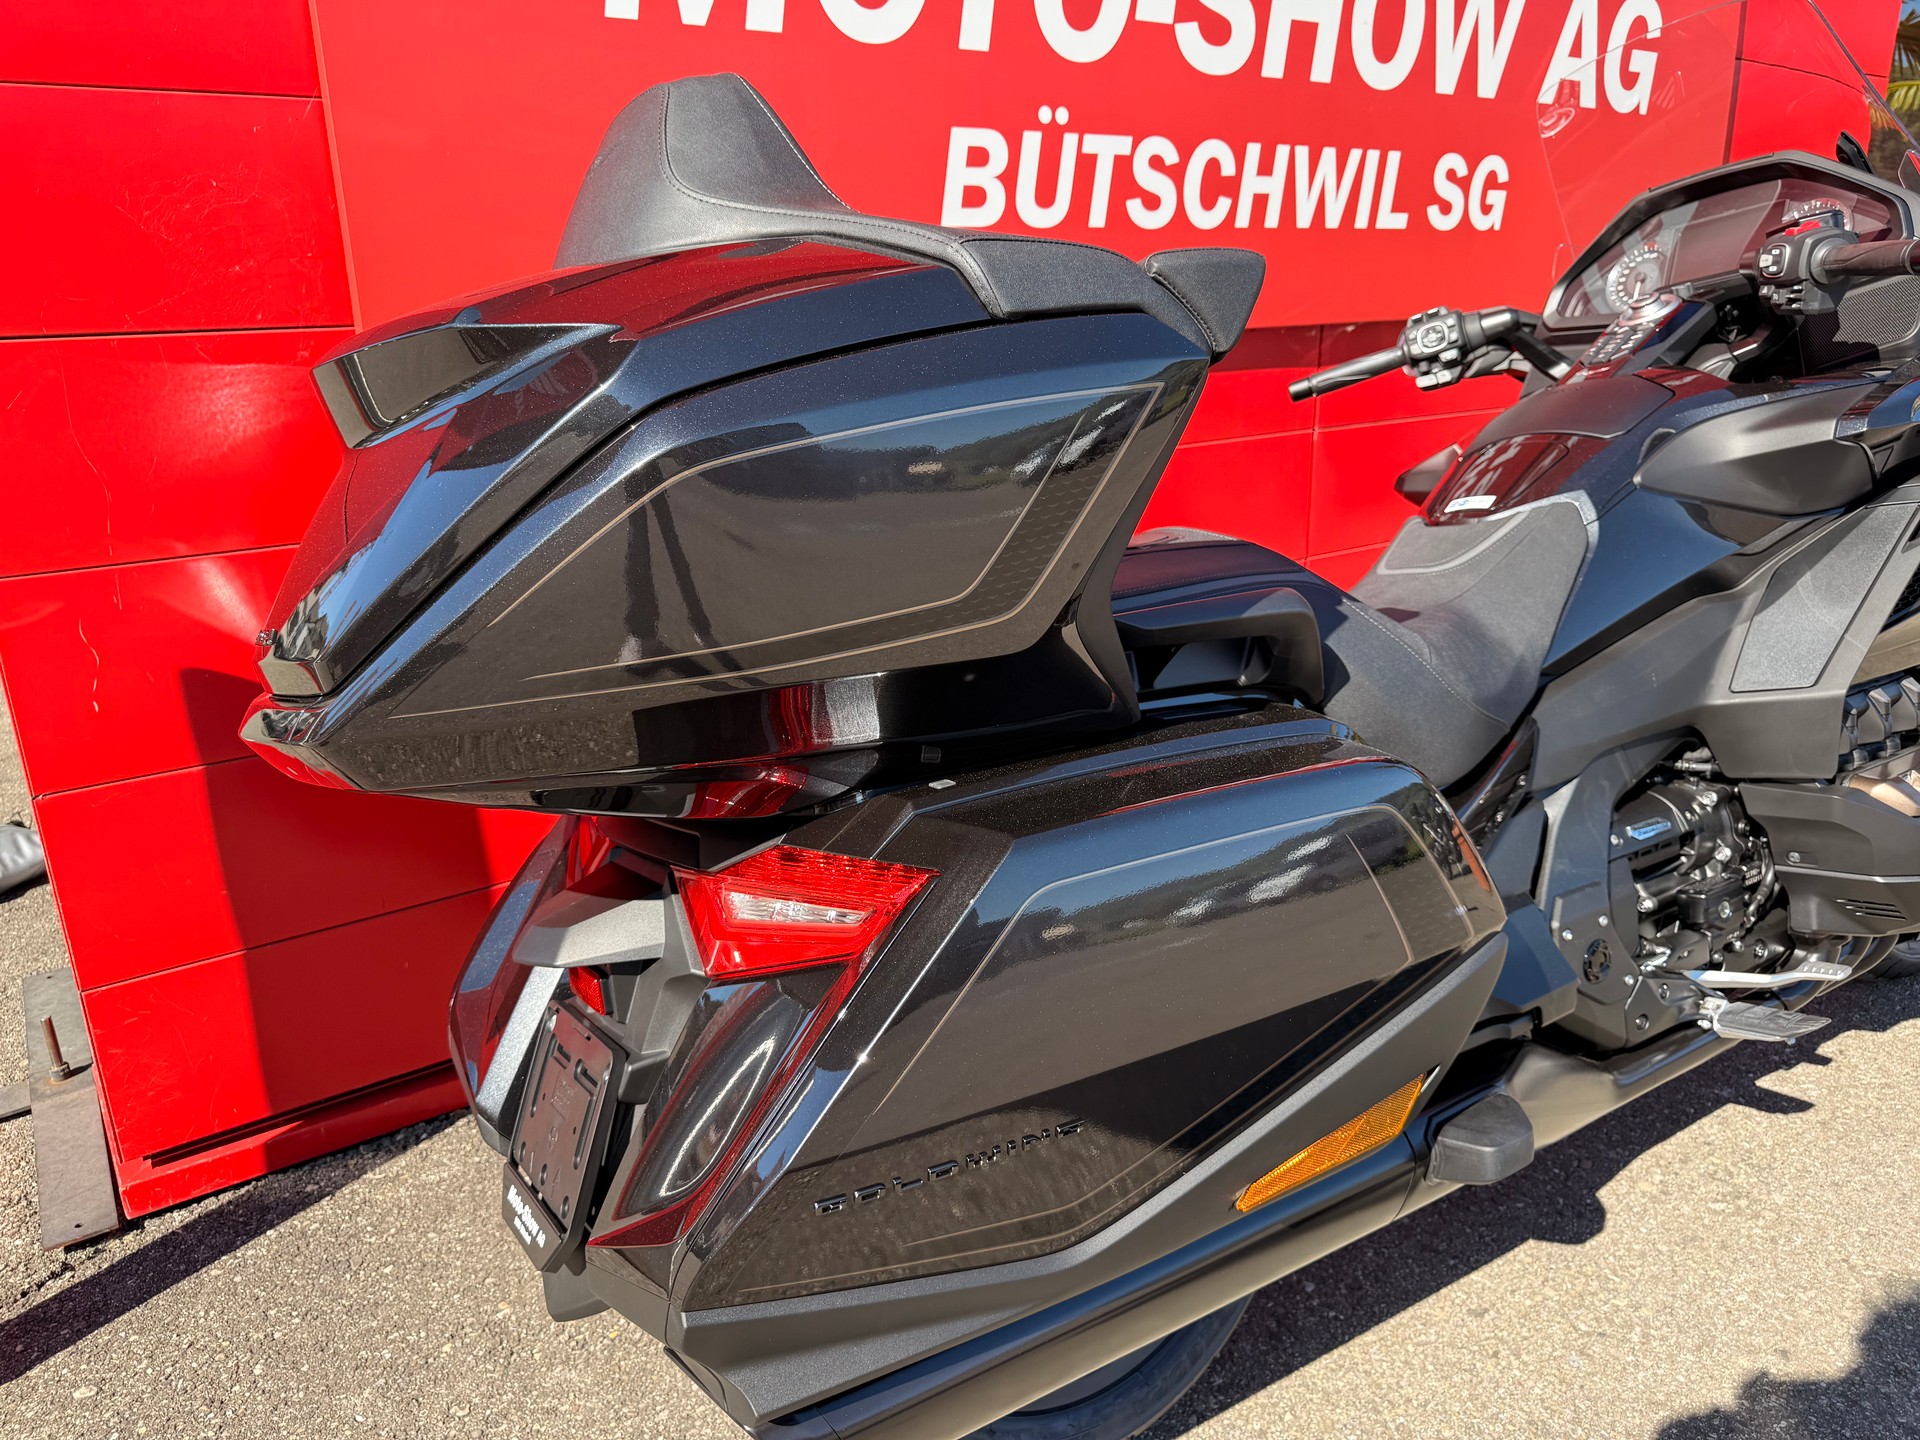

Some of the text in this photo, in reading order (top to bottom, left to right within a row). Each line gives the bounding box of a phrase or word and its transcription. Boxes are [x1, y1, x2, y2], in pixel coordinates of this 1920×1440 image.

[604, 0, 1663, 116] -SHOW AG
[940, 105, 1510, 231] BÜTSCHWIL SG
[813, 1118, 1087, 1216] GOLDWING
